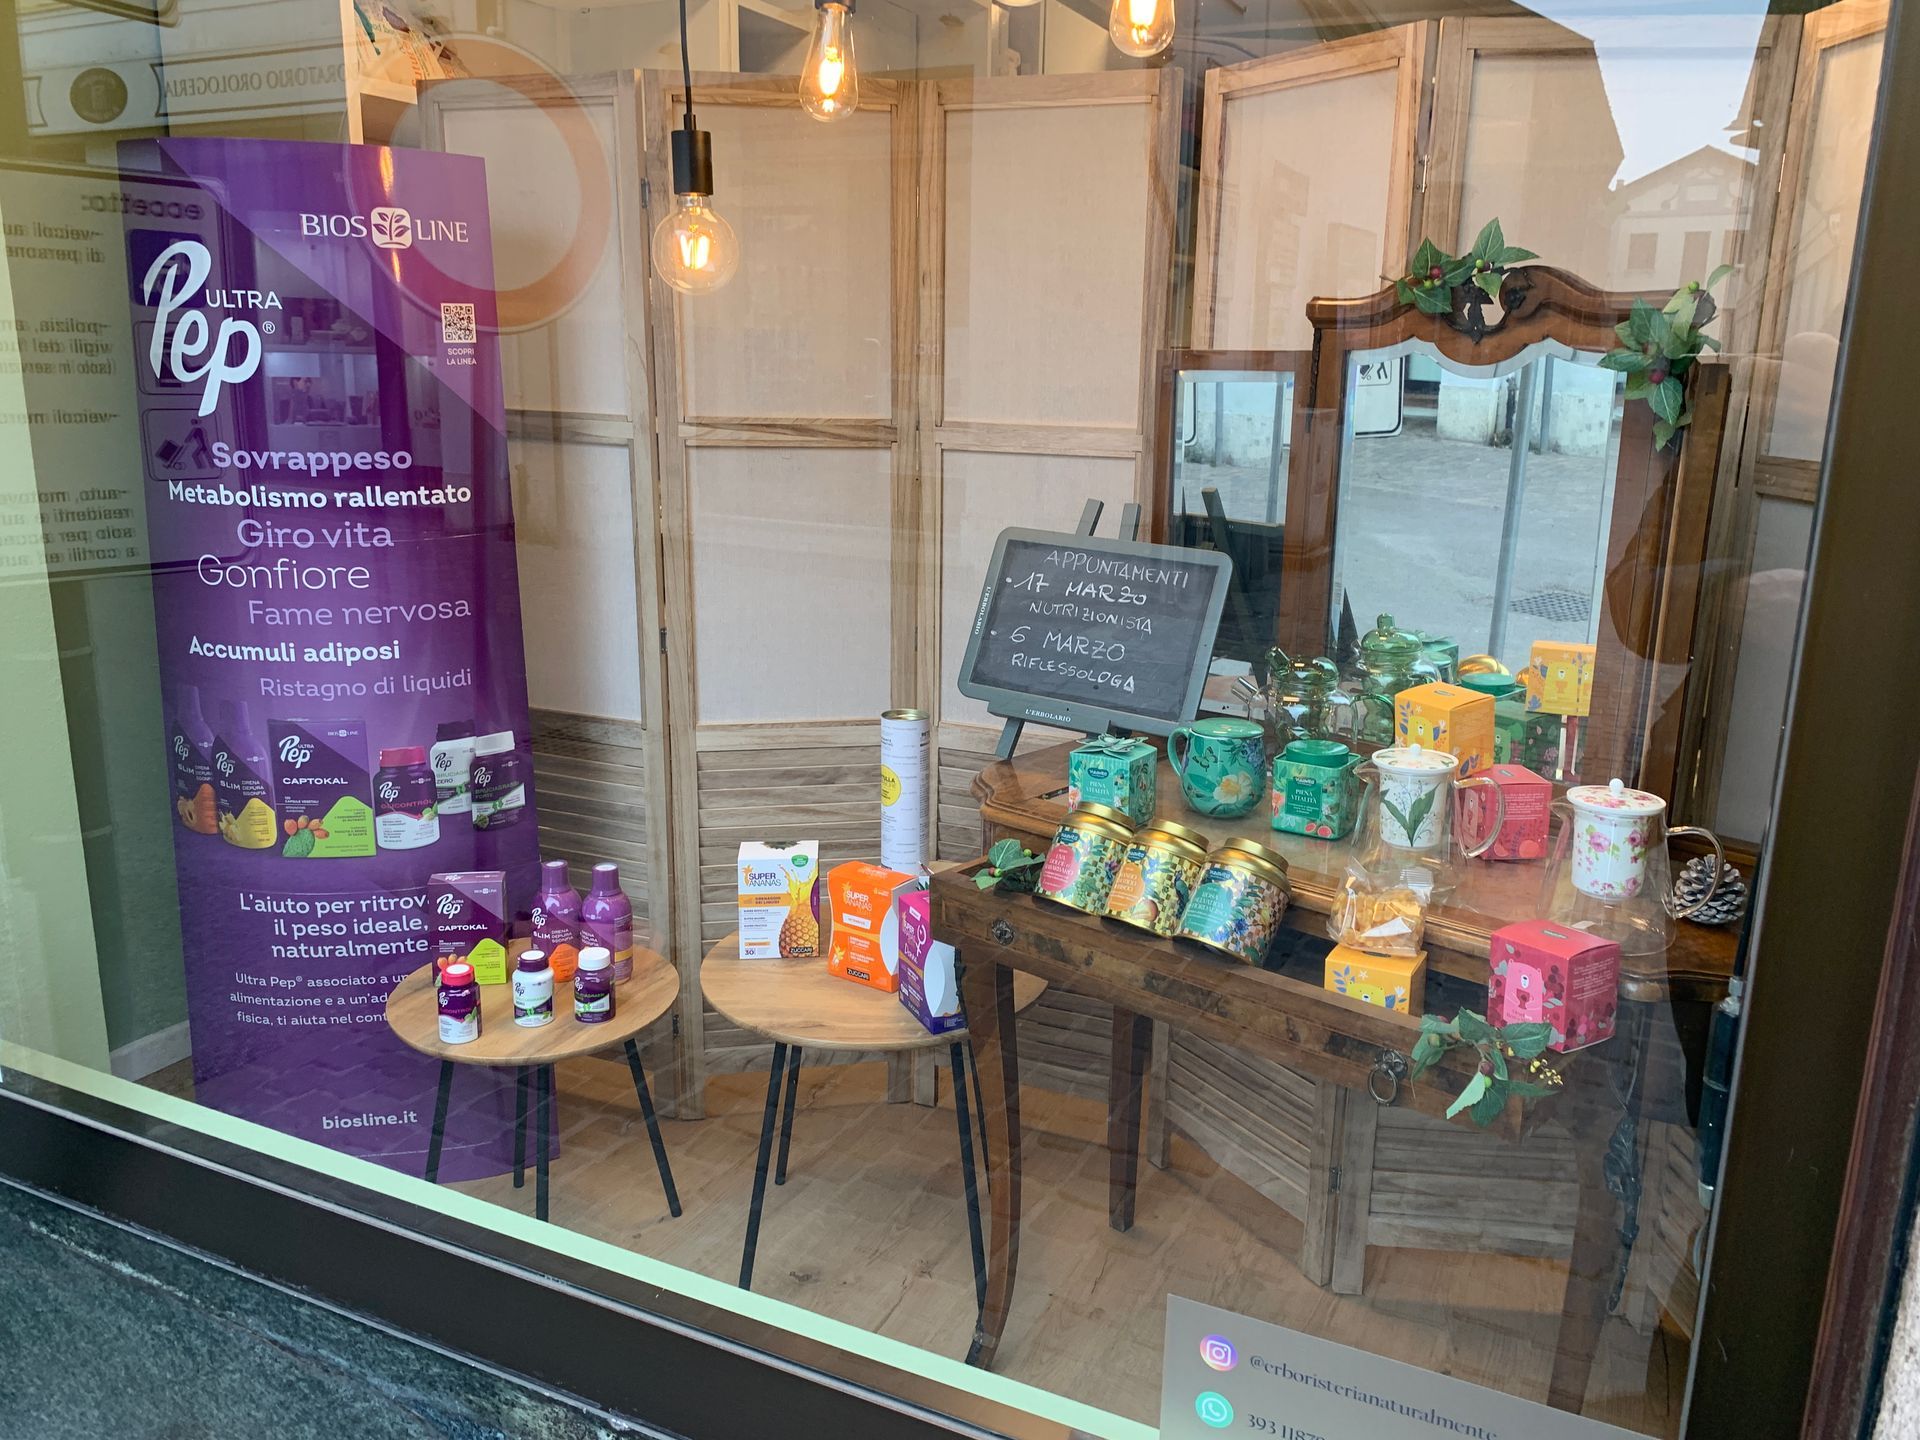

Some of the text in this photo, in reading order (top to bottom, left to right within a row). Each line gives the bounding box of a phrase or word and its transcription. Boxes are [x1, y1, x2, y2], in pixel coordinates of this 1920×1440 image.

[300, 213, 469, 243] BIOS LINE
[205, 289, 283, 310] ULTRA
[446, 358, 477, 366] LA LINEA
[447, 348, 475, 356] SCOPRI
[211, 441, 414, 477] Sovrappeso
[167, 479, 472, 508] Metabolismo rallentato
[236, 518, 395, 549] Giro vita
[197, 554, 371, 590] Gonfiore
[1043, 550, 1190, 589] APPUNTAMENTI
[1013, 571, 1148, 606] 17 MARZO
[248, 599, 472, 626] Fame nervosa
[1028, 601, 1152, 636] NUTRIZIONISTA
[189, 635, 401, 667] Accumuli adiposi
[1009, 625, 1126, 662] 6 MARZO
[260, 668, 473, 702] Ristagno di liquidi
[1011, 652, 1136, 694] RIFLESSOLOGA
[1025, 708, 1072, 723] L'ERBOLARIO
[279, 735, 312, 769] Pep
[435, 752, 453, 772] Pep
[216, 752, 234, 778] Pep
[474, 766, 492, 788] Pep
[220, 780, 241, 791] SLIM
[282, 777, 349, 786] CAPTOKAL
[379, 781, 399, 803] Pep
[749, 872, 776, 880] SUPER
[749, 879, 782, 887] ANANAS
[239, 892, 430, 918] L'aiuto per ritrov
[436, 893, 461, 919] Pep
[847, 890, 870, 902] SUPER
[273, 915, 429, 940] il peso ideale,
[437, 923, 488, 932] CAPTOKAL
[531, 907, 546, 929] Pep
[235, 972, 267, 987] Ultra
[307, 975, 376, 988] associato
[380, 977, 389, 985] a
[229, 992, 321, 1007] alimentazione
[324, 998, 333, 1006] e
[337, 998, 346, 1006] a
[236, 1011, 274, 1027] fisica,
[276, 1016, 287, 1026] ti
[291, 1015, 328, 1026] aiuta
[330, 1013, 352, 1025] nel
[321, 1110, 418, 1130] biosline.it
[1249, 1354, 1498, 1440] @erboristerianaturalmente
[1247, 1412, 1277, 1435] 393
